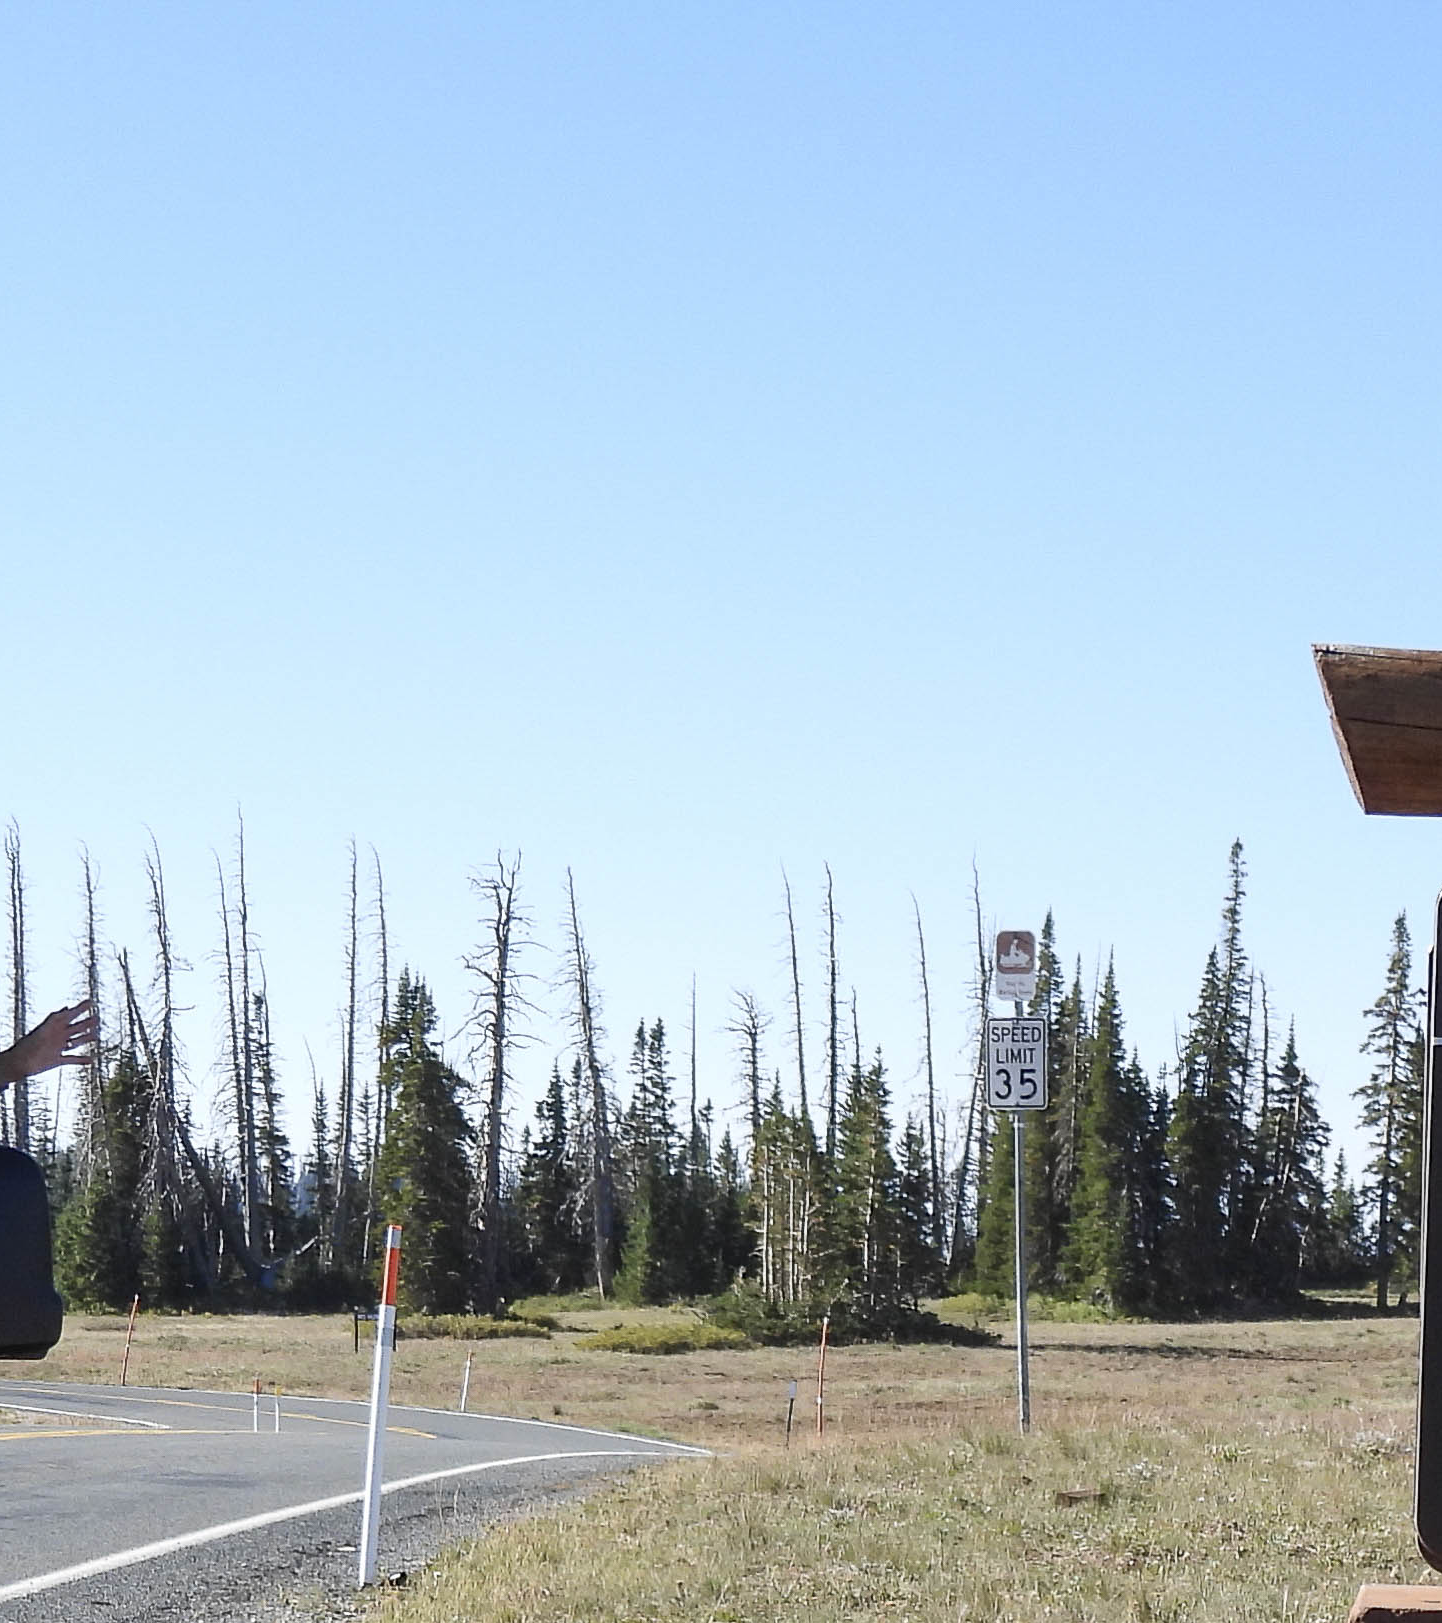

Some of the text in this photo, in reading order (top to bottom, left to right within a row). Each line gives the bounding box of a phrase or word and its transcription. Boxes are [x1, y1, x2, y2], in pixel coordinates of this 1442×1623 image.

[991, 1026, 1042, 1043] SPEED
[995, 1047, 1036, 1064] LIMIT
[994, 1068, 1038, 1100] 35
